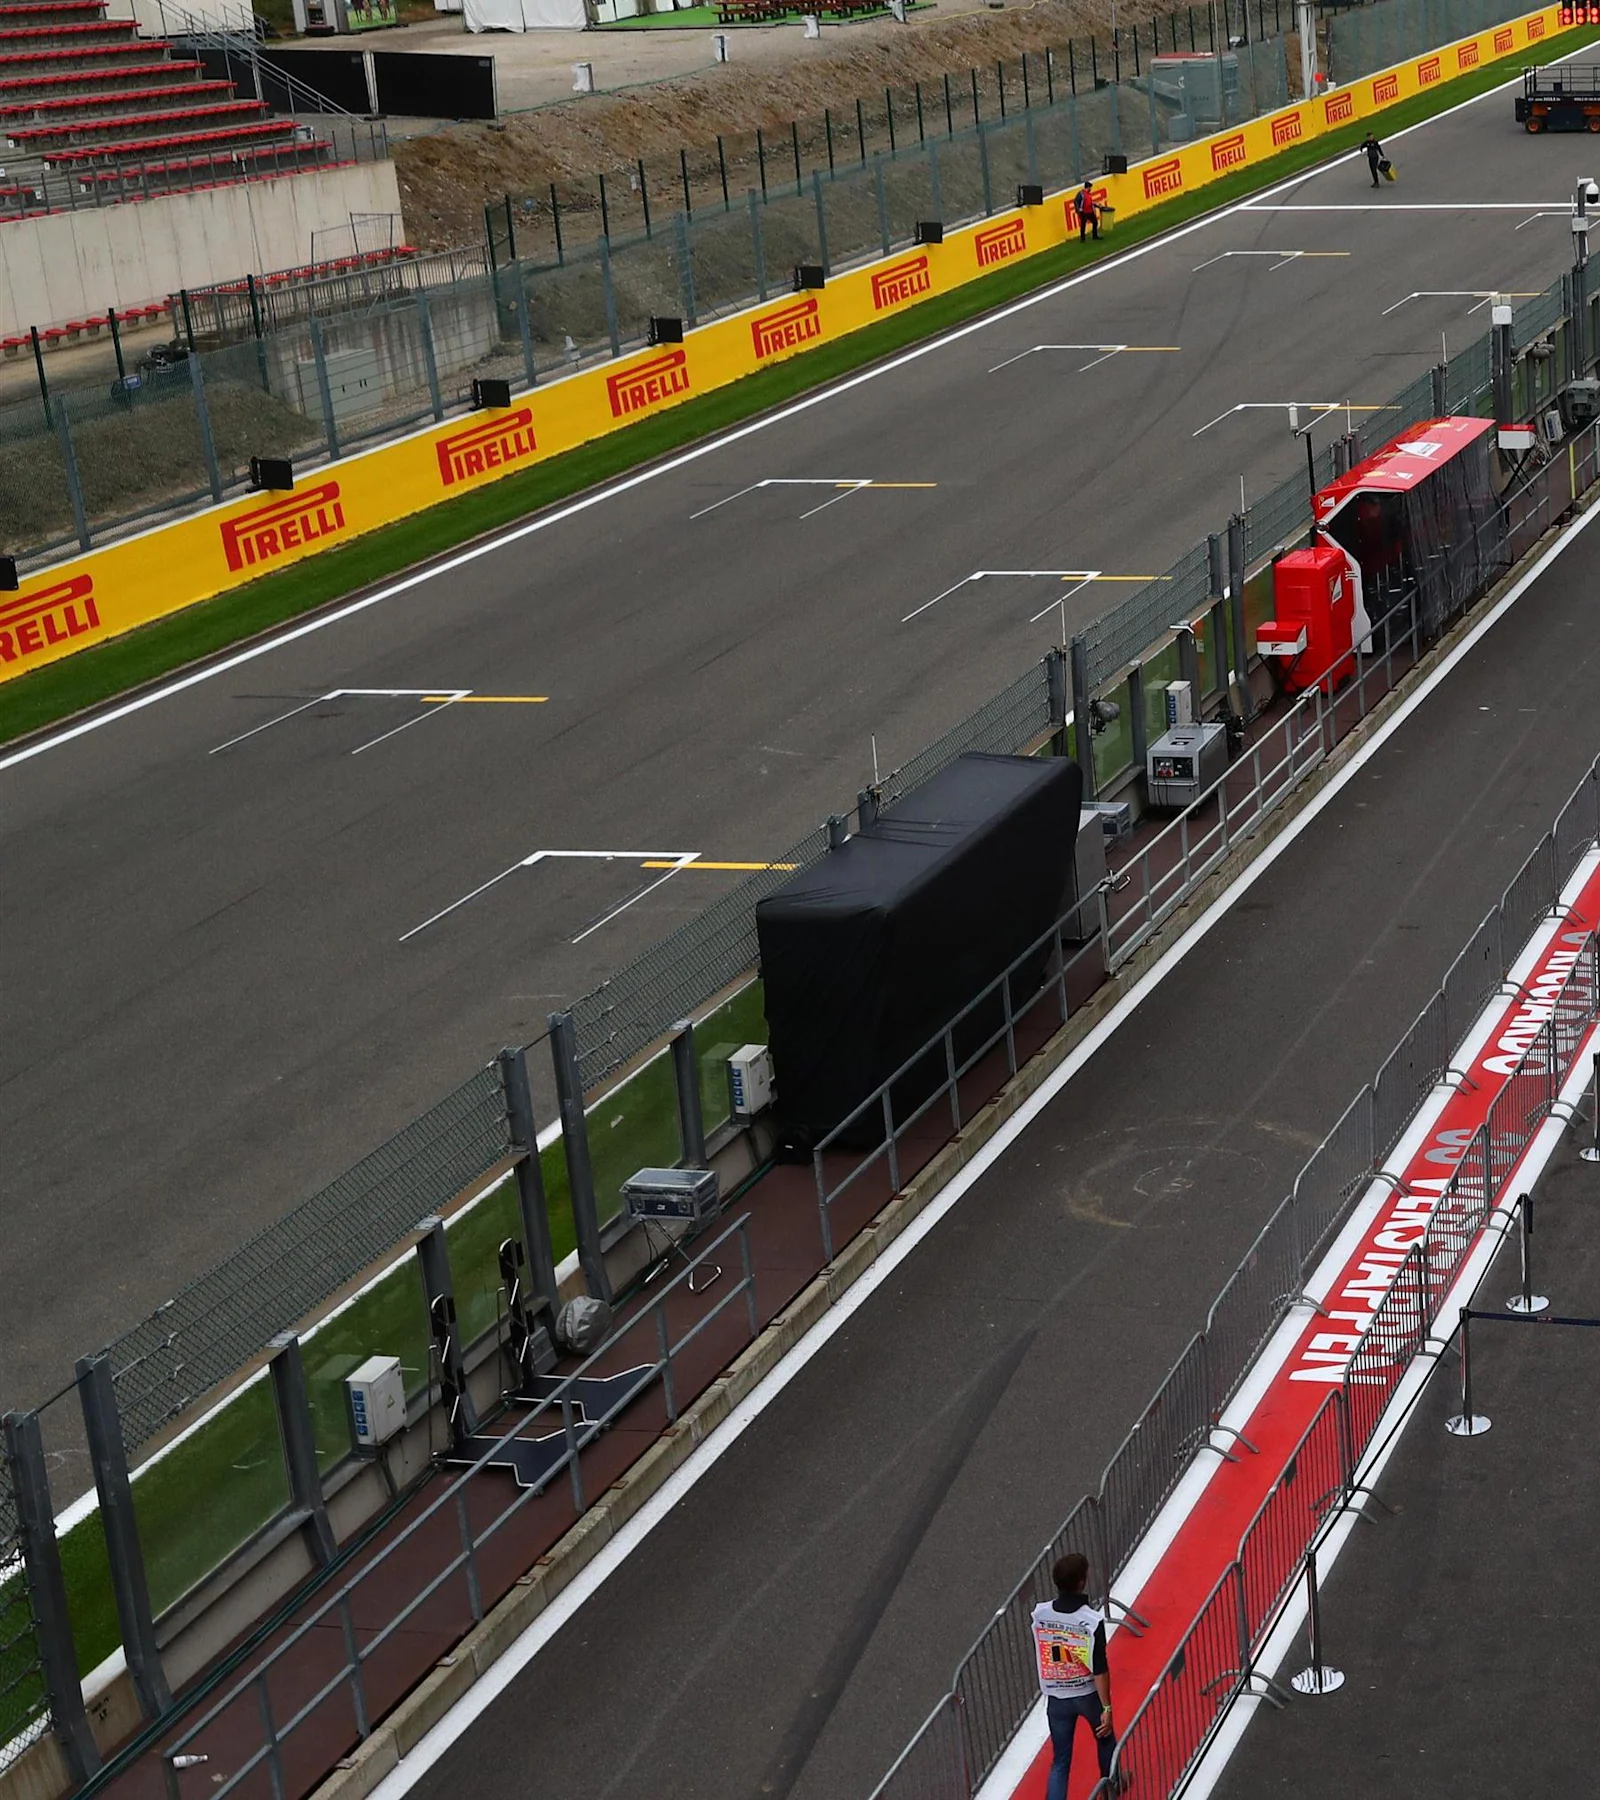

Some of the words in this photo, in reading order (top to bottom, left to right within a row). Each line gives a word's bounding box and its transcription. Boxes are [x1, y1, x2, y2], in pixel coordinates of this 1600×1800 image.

[1458, 42, 1479, 69] PIRELLI
[1494, 28, 1513, 54] PIRELLI
[1373, 74, 1399, 105] PIRELLI
[1417, 57, 1441, 86] PIRELLI
[1325, 92, 1353, 124] PIRELLI
[1271, 111, 1302, 146] PIRELLI
[1211, 134, 1246, 171] PIRELLI
[1143, 159, 1182, 199] PIRELLI
[974, 218, 1026, 267] PIRELLI
[870, 255, 931, 310] PIRELLI
[751, 298, 821, 359] PIRELLI
[606, 349, 690, 418] PIRELLI
[435, 407, 537, 486] PIRELLI
[219, 480, 346, 572] PIRELLI
[0, 574, 100, 662] RELLI
